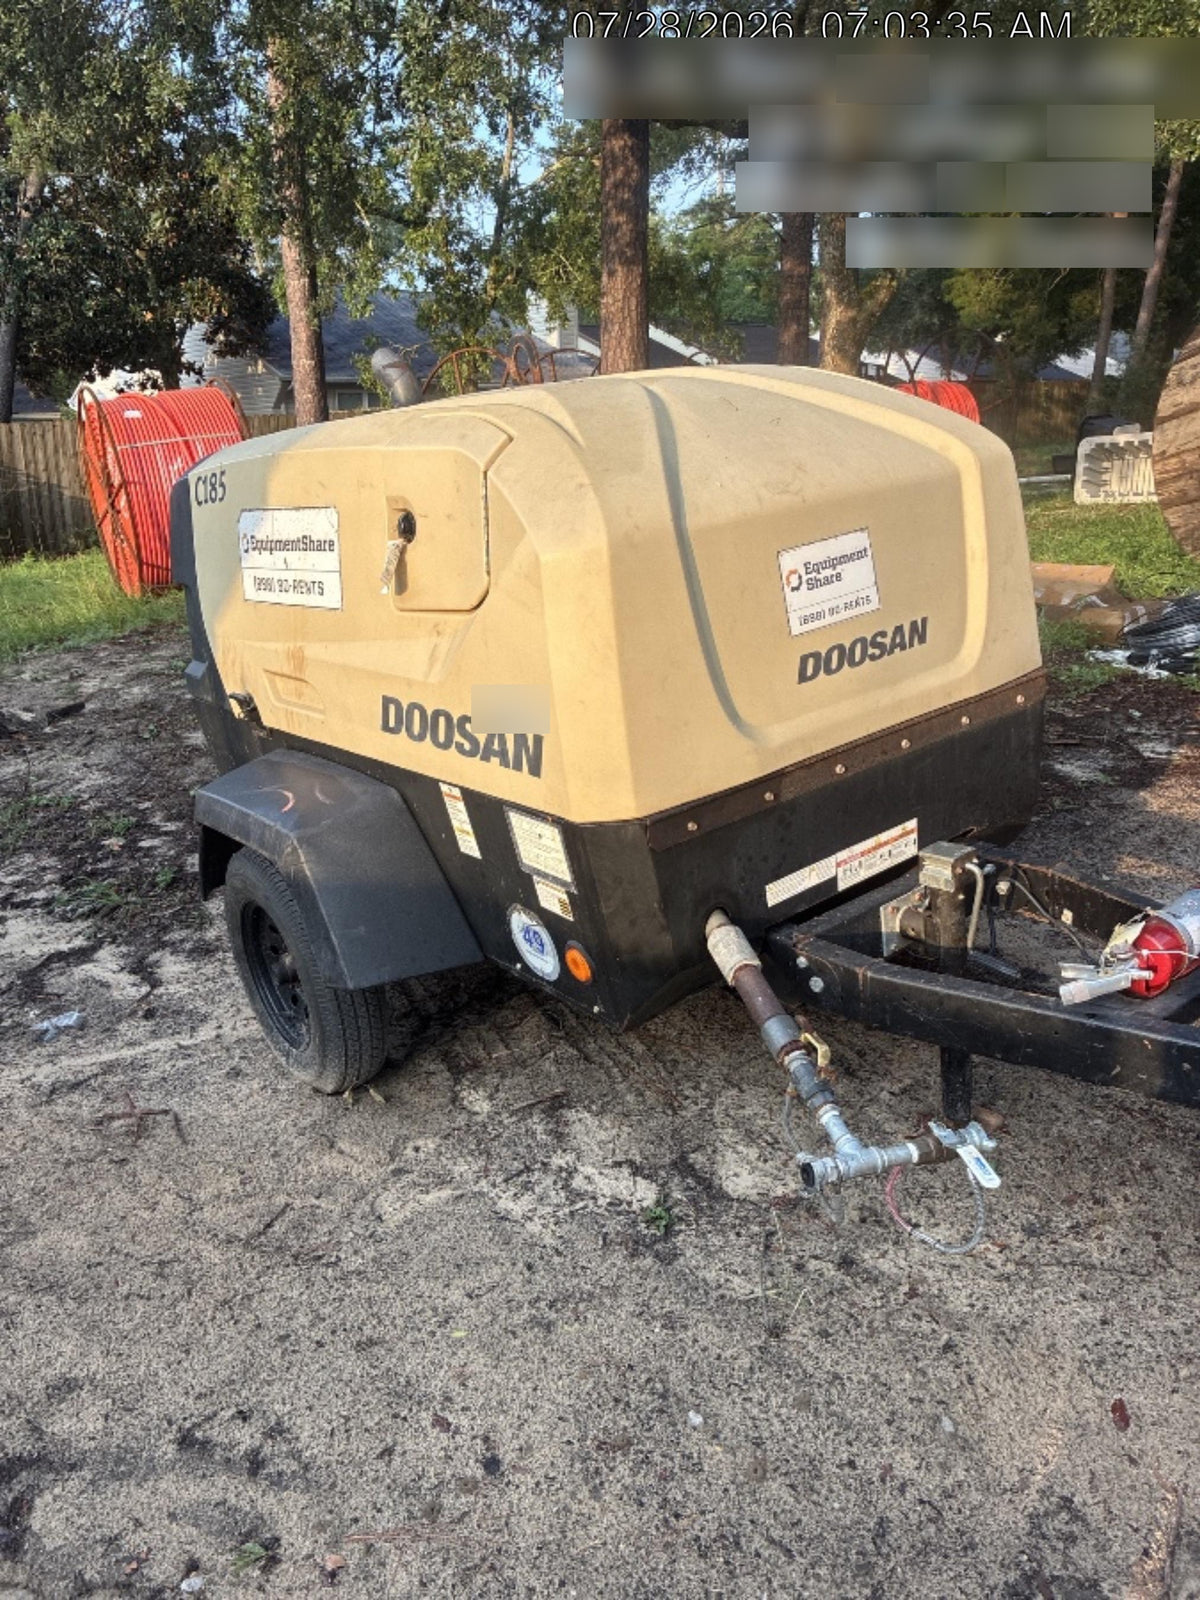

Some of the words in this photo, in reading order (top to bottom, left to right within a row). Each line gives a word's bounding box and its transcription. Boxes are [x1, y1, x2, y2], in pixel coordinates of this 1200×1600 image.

[195, 470, 226, 506] C185
[250, 534, 335, 555] EquipmentShare
[803, 547, 869, 575] Equipment
[806, 571, 843, 591] Share
[797, 616, 929, 685] DOOSAN
[381, 694, 544, 779] DOOSAN
